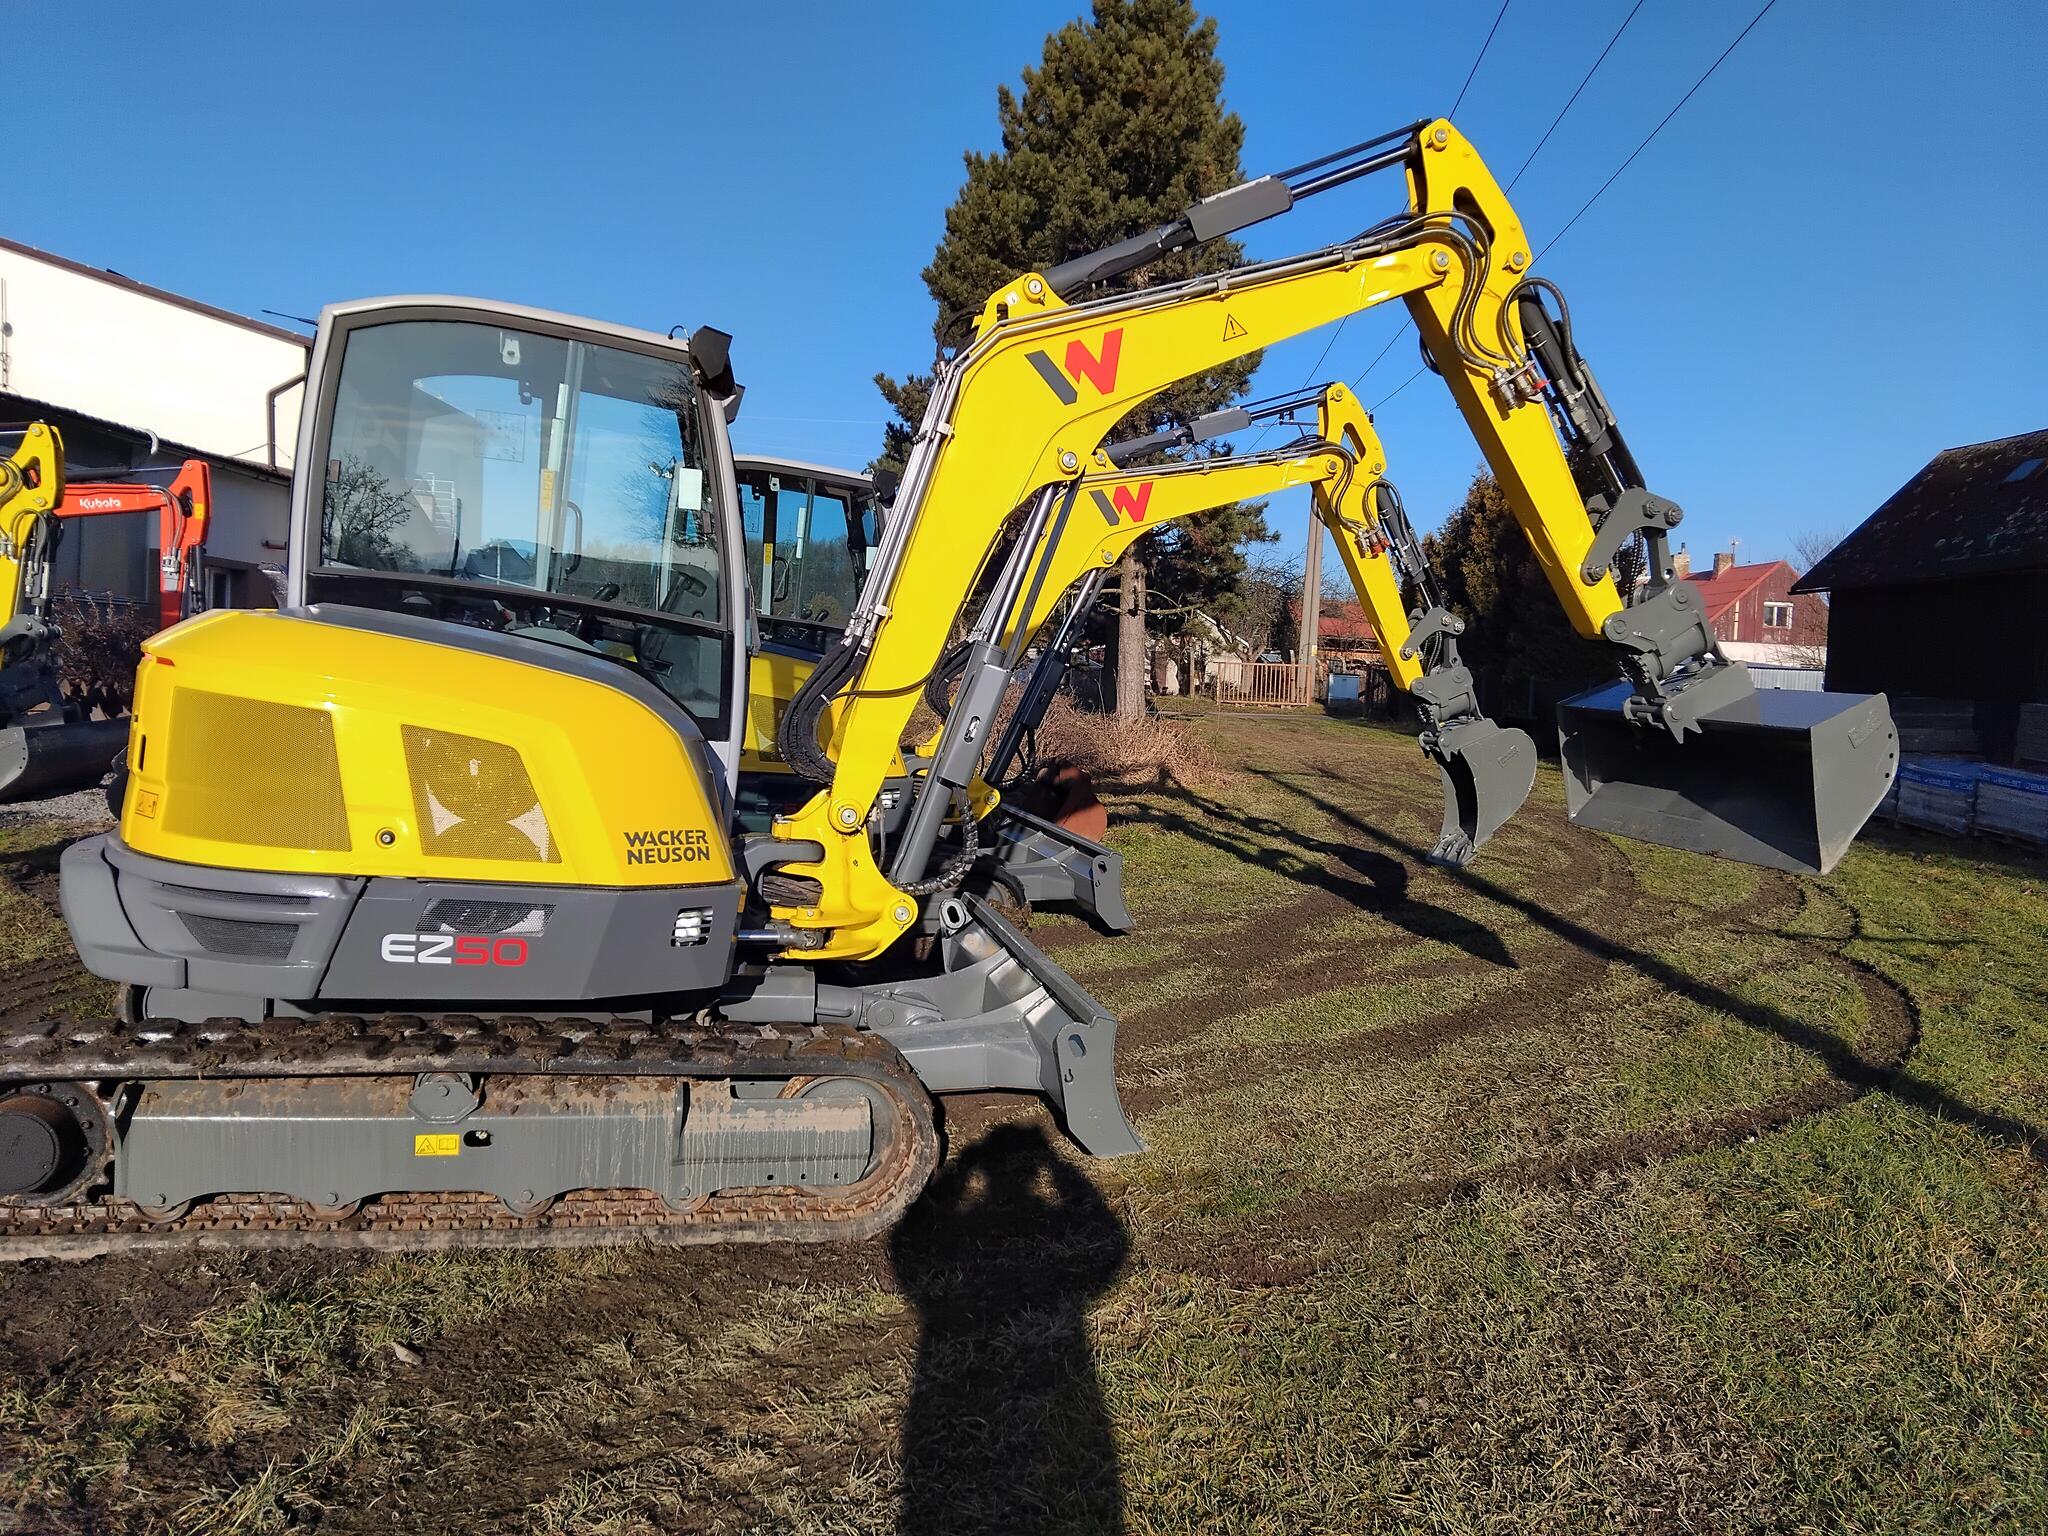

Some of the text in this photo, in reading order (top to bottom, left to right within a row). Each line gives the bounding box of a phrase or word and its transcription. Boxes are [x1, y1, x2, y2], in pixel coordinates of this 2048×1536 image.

[79, 497, 121, 508] Kubota
[623, 830, 708, 847] WACKER
[627, 846, 710, 865] NEUSON
[381, 933, 528, 967] EZ50
